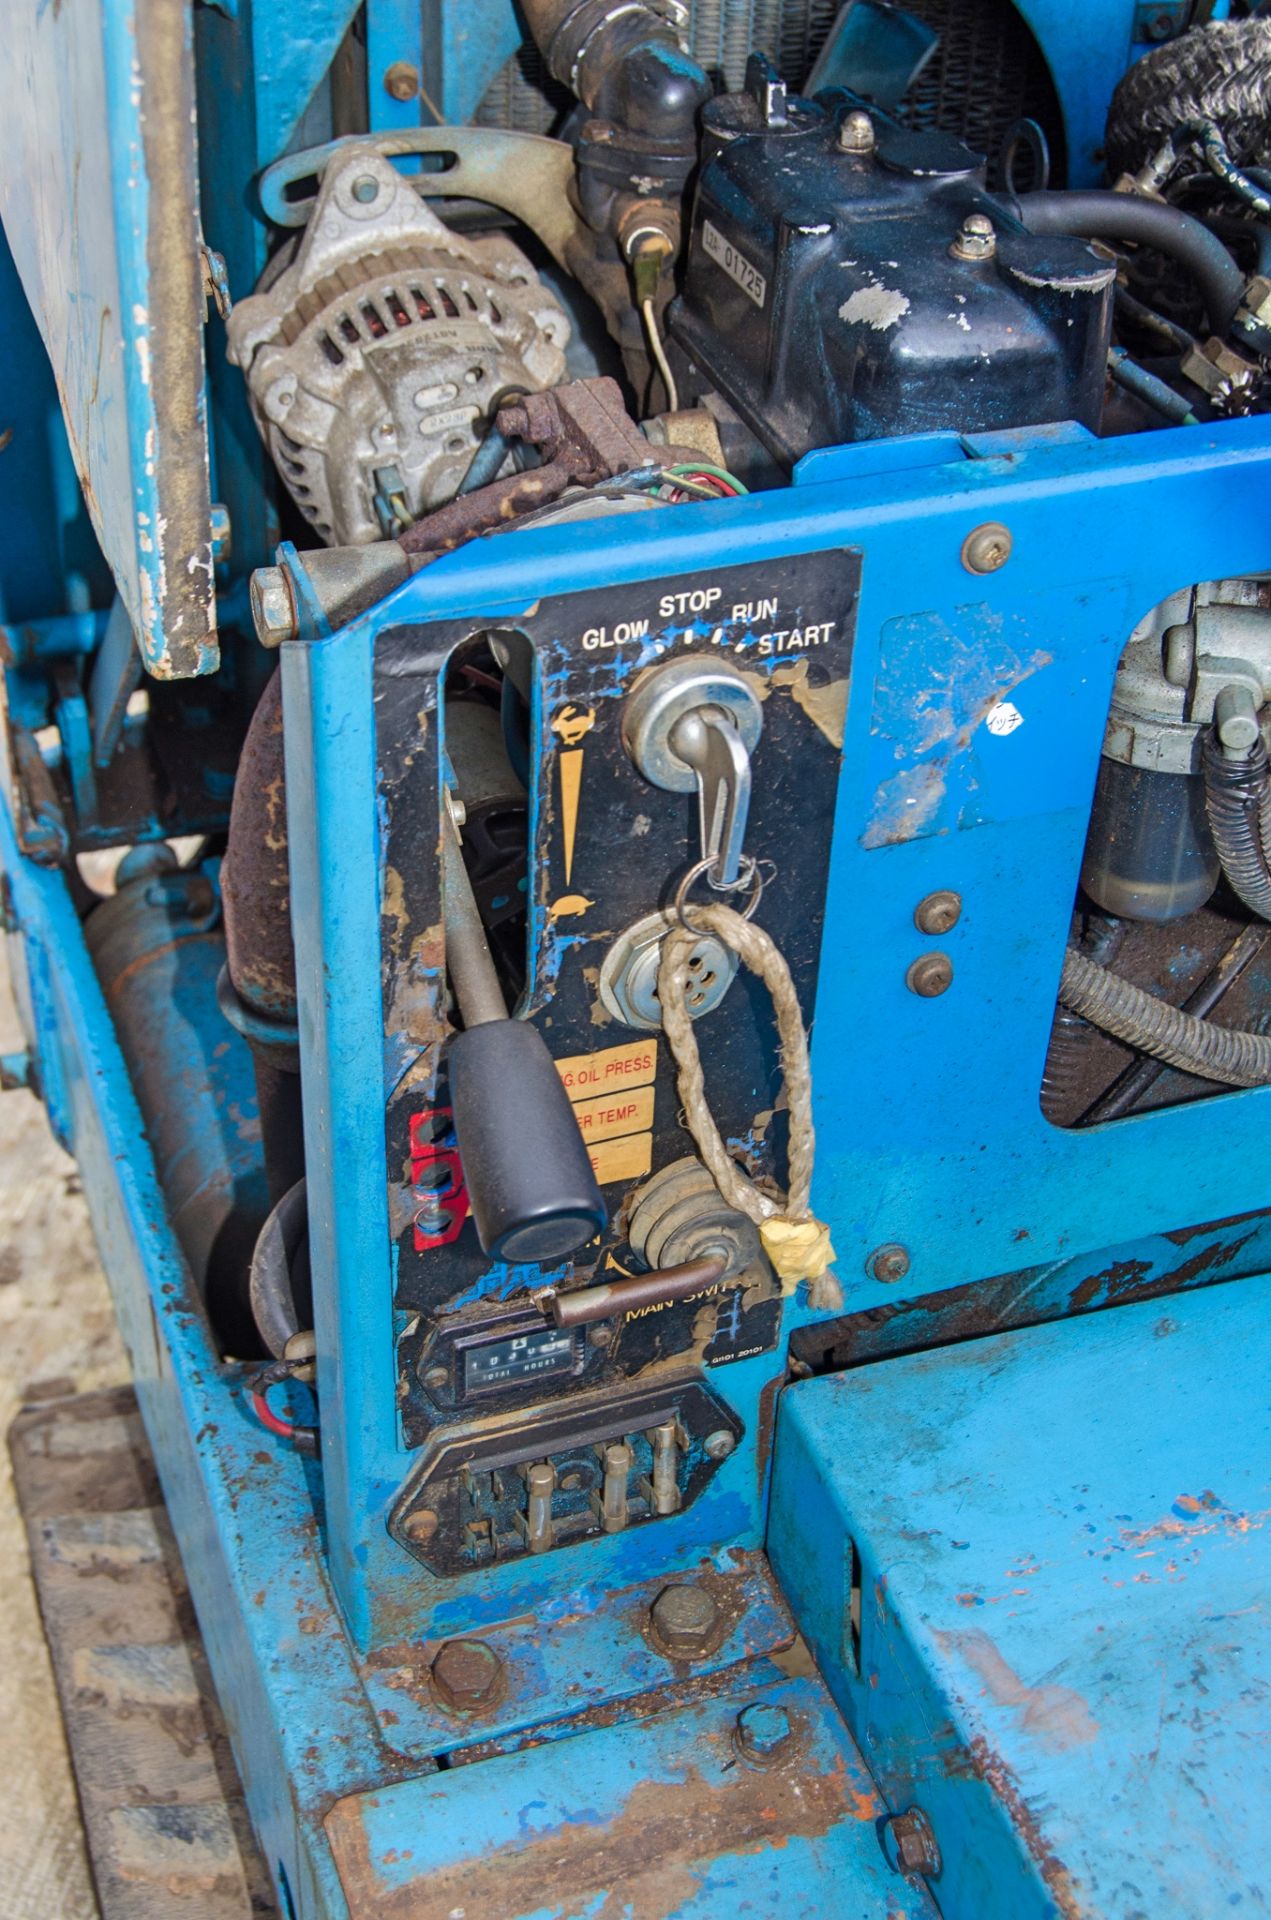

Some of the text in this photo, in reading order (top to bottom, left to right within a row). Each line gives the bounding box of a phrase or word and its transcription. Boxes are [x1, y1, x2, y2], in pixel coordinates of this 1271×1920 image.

[725, 246, 763, 298] 01725
[659, 587, 722, 617] STOP
[732, 598, 778, 623] RUN
[582, 619, 649, 650] GLOW
[758, 622, 836, 655] START
[605, 1055, 654, 1078] PRESS.
[598, 1104, 638, 1125] TEMP.
[626, 1300, 674, 1322] MAIN
